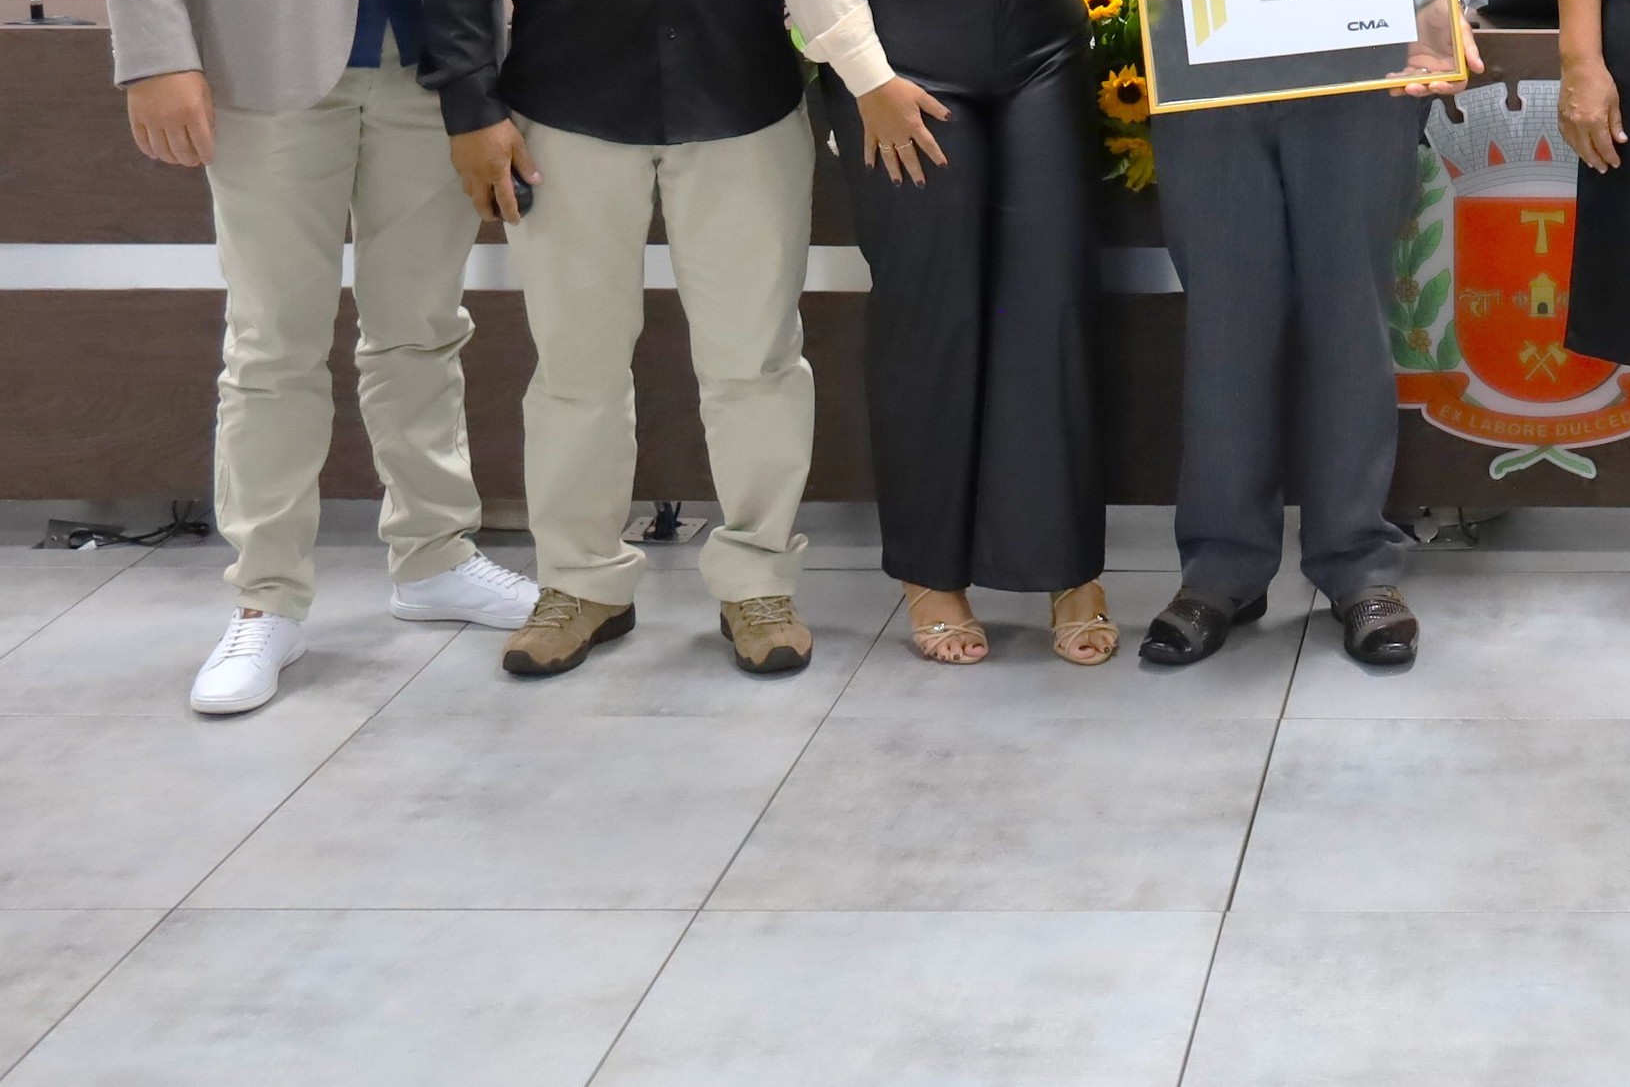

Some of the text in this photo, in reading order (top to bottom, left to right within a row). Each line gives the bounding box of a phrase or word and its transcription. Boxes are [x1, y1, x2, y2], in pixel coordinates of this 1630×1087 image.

[1348, 19, 1389, 31] CMA
[1439, 403, 1463, 423] EX
[1469, 417, 1548, 438] LABORE
